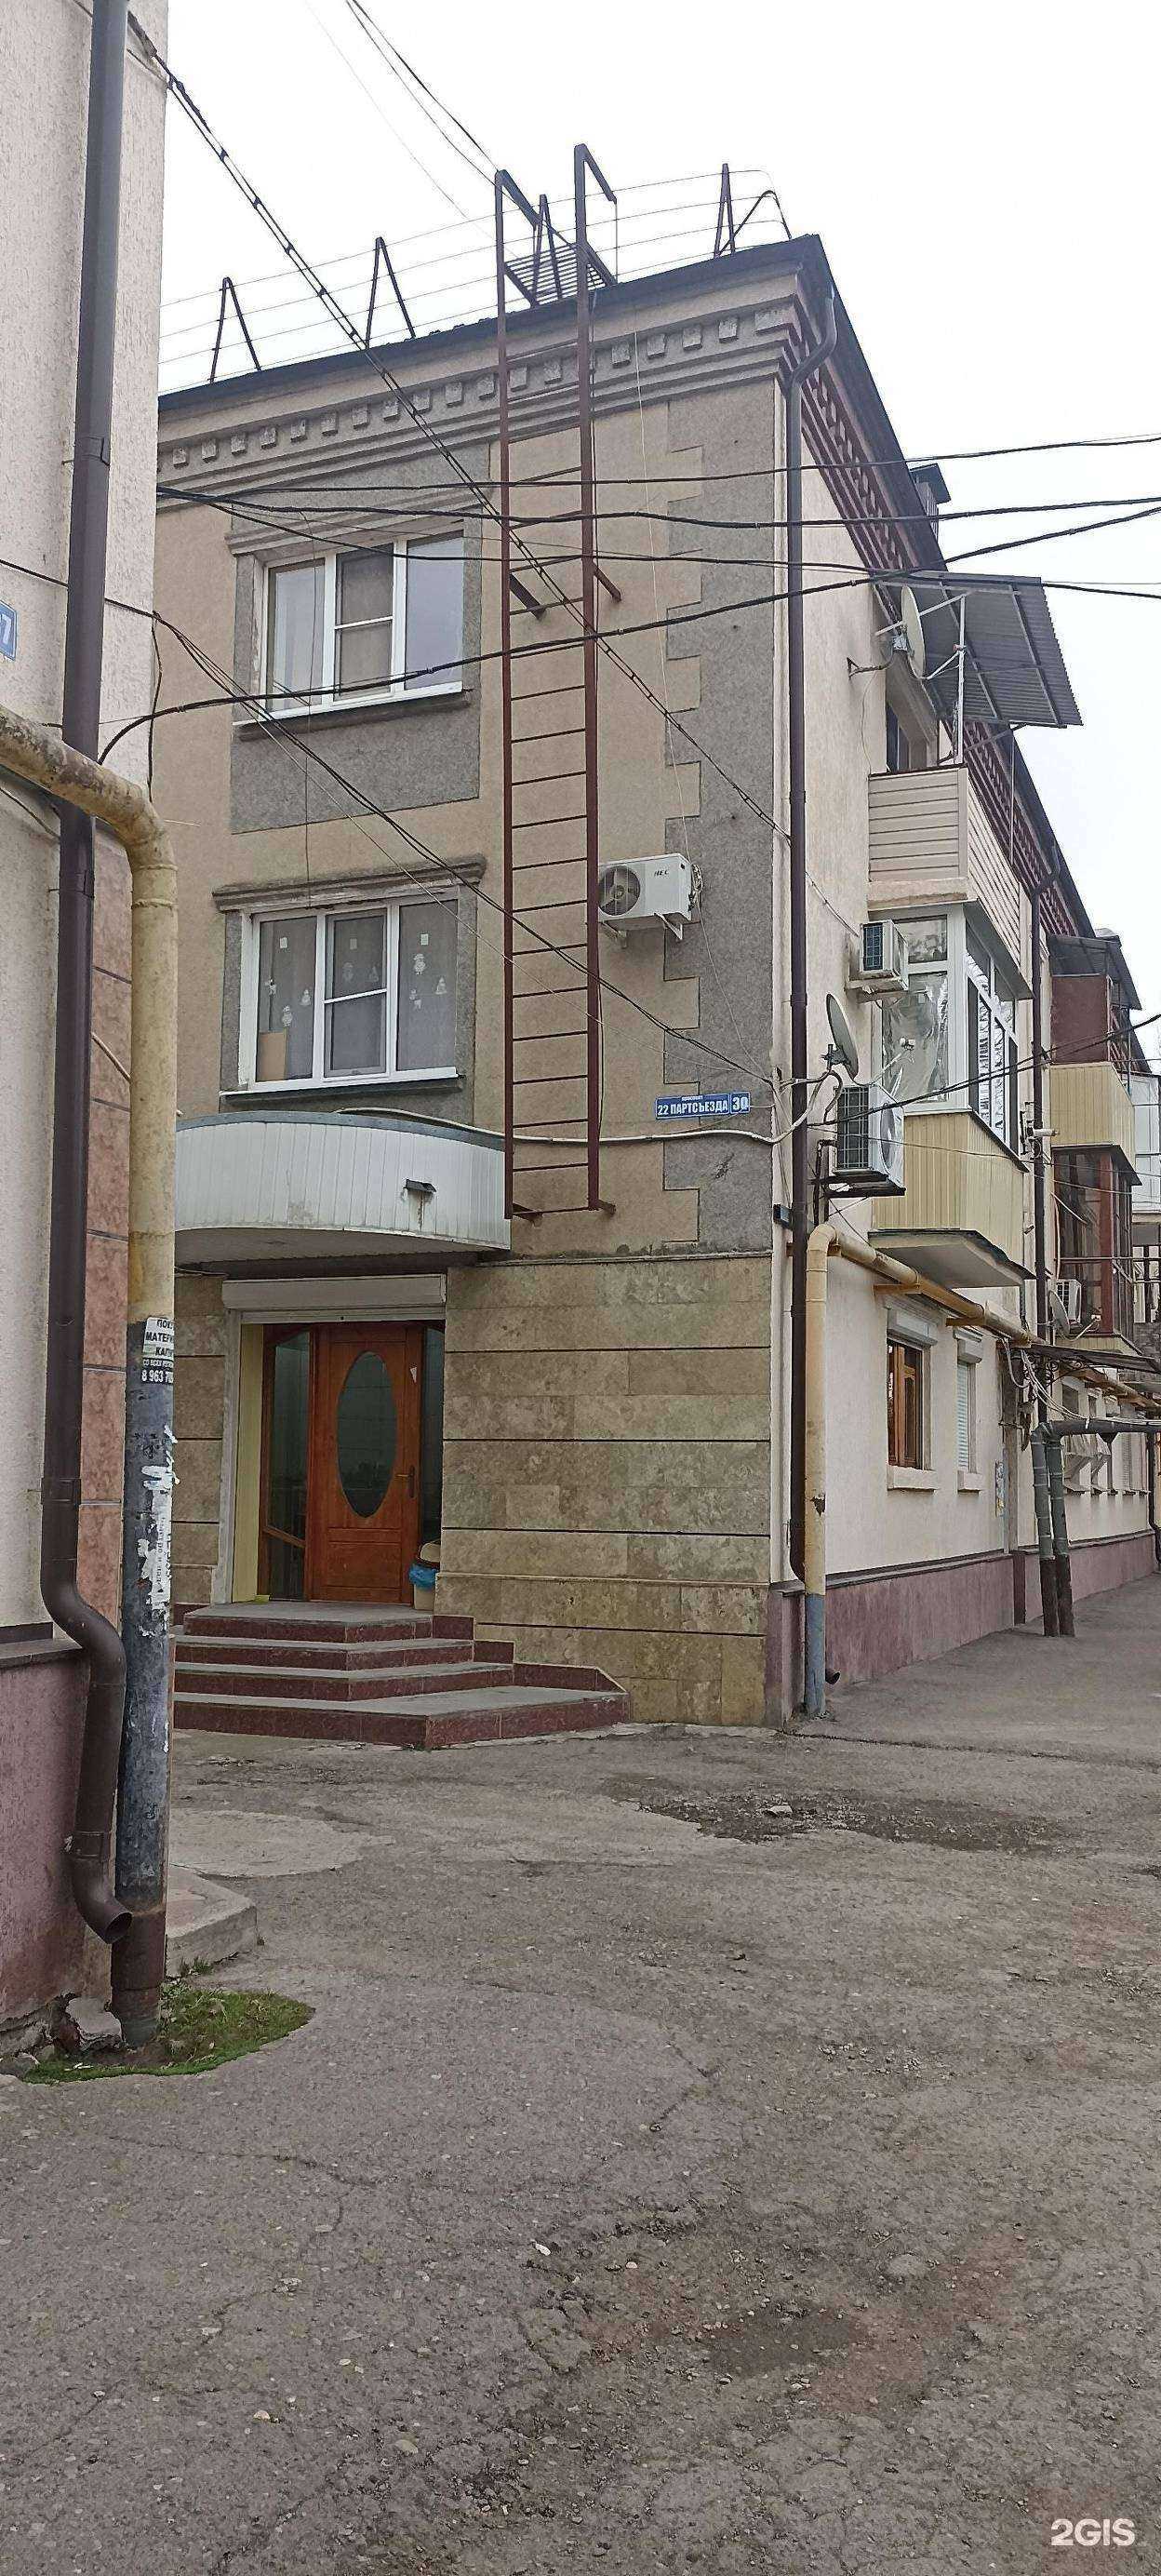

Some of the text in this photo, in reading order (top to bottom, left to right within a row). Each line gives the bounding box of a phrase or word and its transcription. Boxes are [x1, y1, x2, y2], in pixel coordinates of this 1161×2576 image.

[657, 1100, 728, 1116] 22 ПАРТСЪЕЗДА
[732, 1096, 749, 1110] 30
